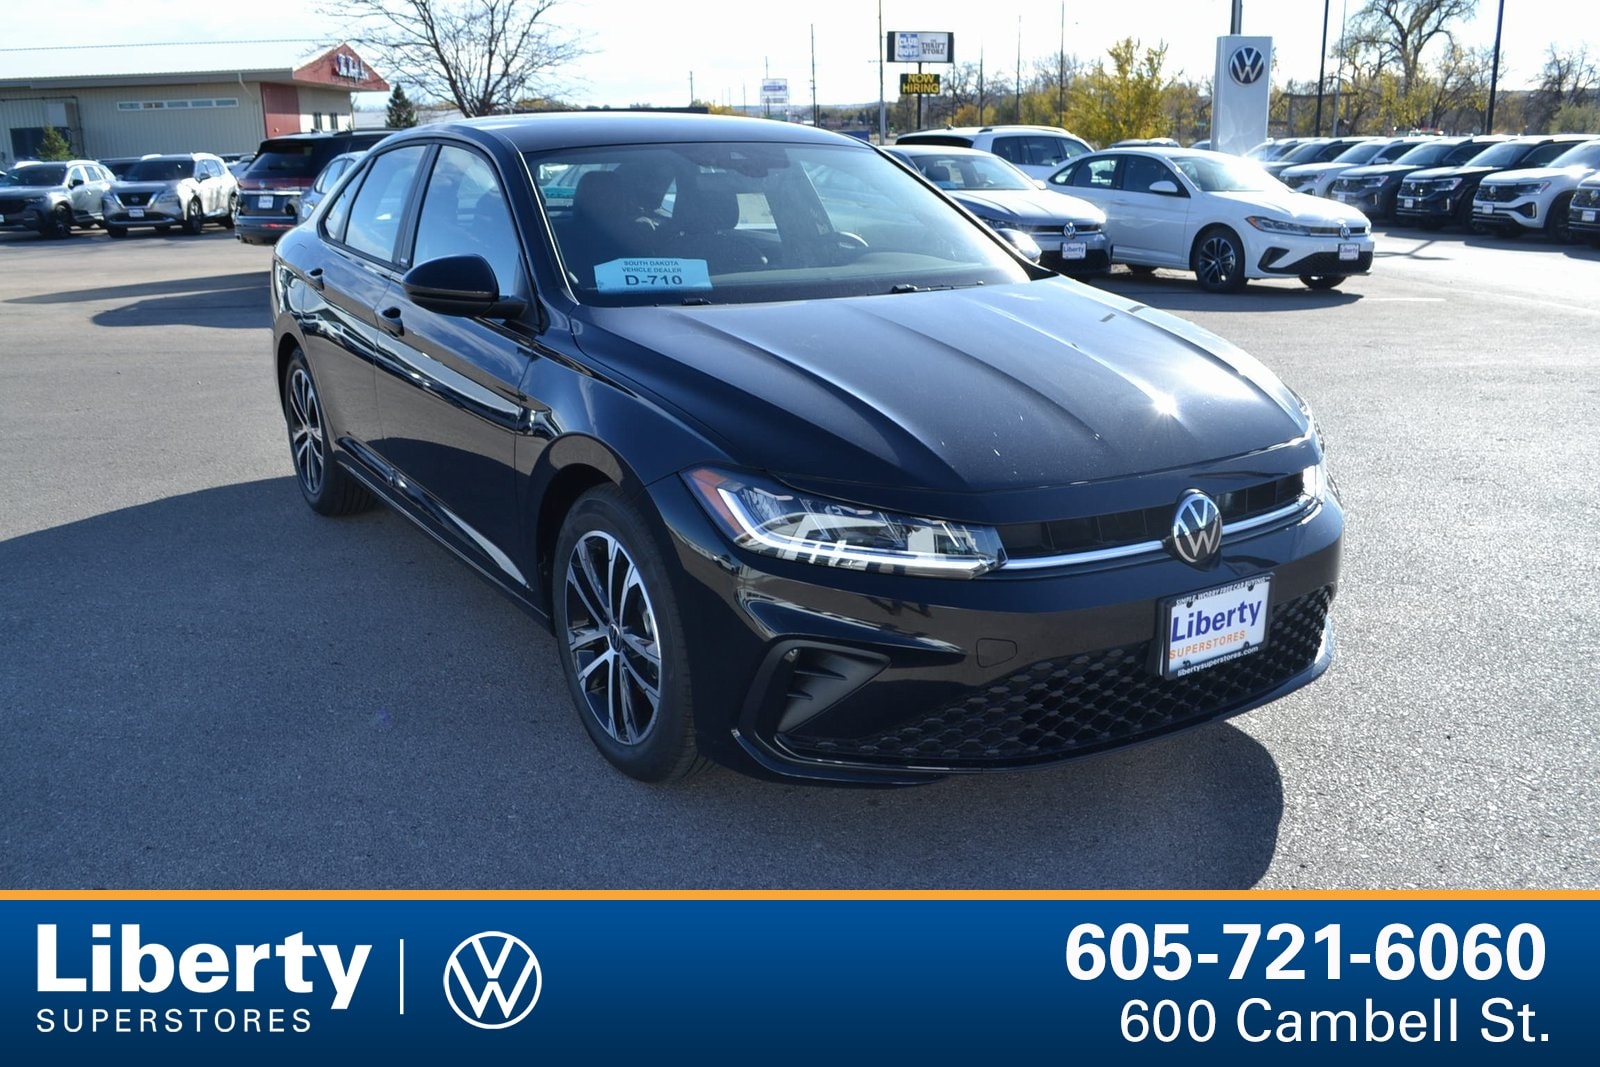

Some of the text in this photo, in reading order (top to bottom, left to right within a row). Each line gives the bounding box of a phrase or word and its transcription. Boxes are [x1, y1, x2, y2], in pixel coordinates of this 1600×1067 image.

[902, 83, 939, 93] HIRING
[908, 74, 935, 83] NOW
[624, 274, 683, 286] D-710
[1171, 599, 1262, 642] Liberty
[1169, 630, 1246, 660] SUPERSTORES
[1177, 645, 1259, 677] libertysuperstores.com
